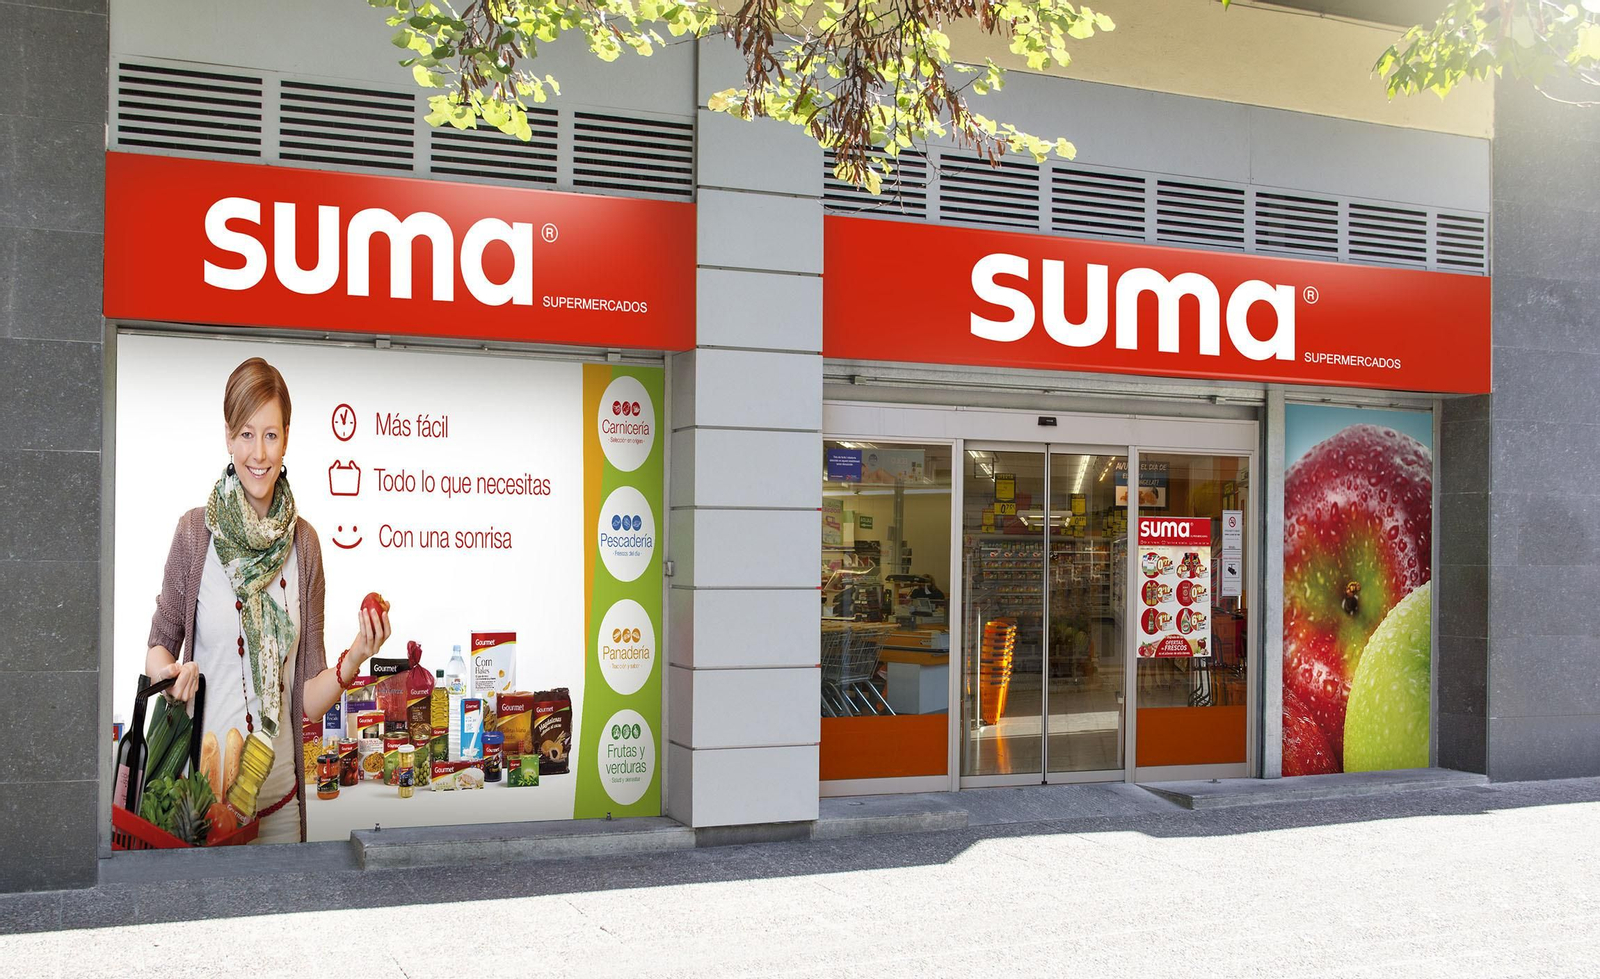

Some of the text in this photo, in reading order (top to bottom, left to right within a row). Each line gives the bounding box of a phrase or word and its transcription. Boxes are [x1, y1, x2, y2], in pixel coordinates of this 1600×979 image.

[203, 196, 534, 306] suma
[542, 295, 648, 314] SUPERMERCADOS
[970, 252, 1296, 361] suma
[1304, 351, 1402, 370] SUPERMERCADOS
[375, 412, 449, 438] Más fácil
[601, 418, 650, 436] Carnicería
[373, 467, 551, 499] Todo lo que necesitas
[378, 524, 513, 549] Con una sonrisa
[1140, 521, 1190, 538] suma
[600, 532, 653, 548] Pescadería
[475, 638, 496, 646] Gourmet
[602, 645, 650, 660] Panadería
[373, 663, 398, 673] Gourmet
[475, 656, 493, 667] Corn
[410, 688, 430, 696] Gourmet
[501, 703, 525, 712] Gourmet
[536, 706, 554, 714] Gourmet
[607, 743, 646, 760] Frutas y
[434, 766, 455, 774] Gourmet
[605, 759, 647, 775] verduras
